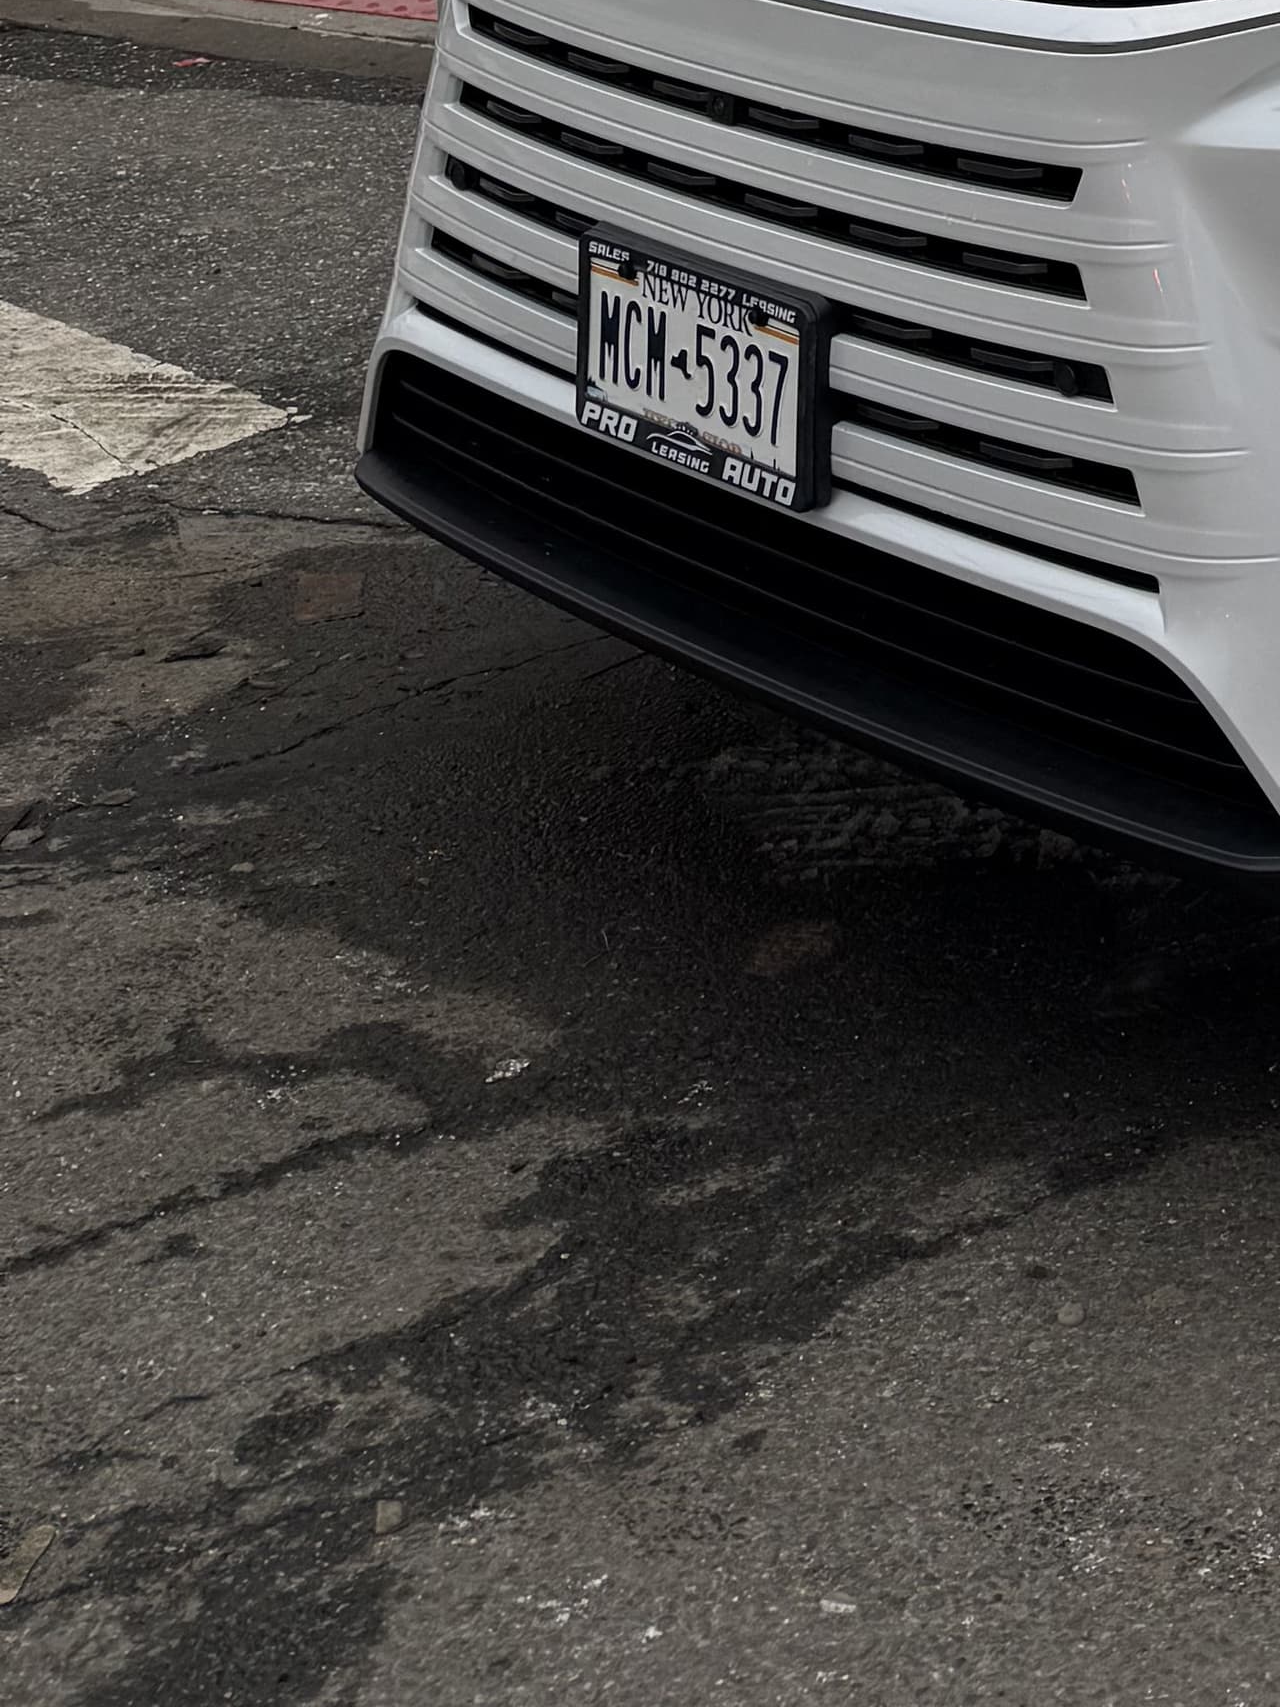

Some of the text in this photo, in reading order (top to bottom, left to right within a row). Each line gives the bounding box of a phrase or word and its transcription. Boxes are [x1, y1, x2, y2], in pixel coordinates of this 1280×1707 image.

[588, 241, 630, 262] SALES
[646, 259, 667, 275] 718
[671, 270, 697, 288] 902
[701, 280, 736, 303] 2277
[641, 274, 754, 337] NEW YORK
[581, 399, 638, 443] PRO
[651, 441, 710, 474] LEASING
[721, 459, 797, 507] AUTO
